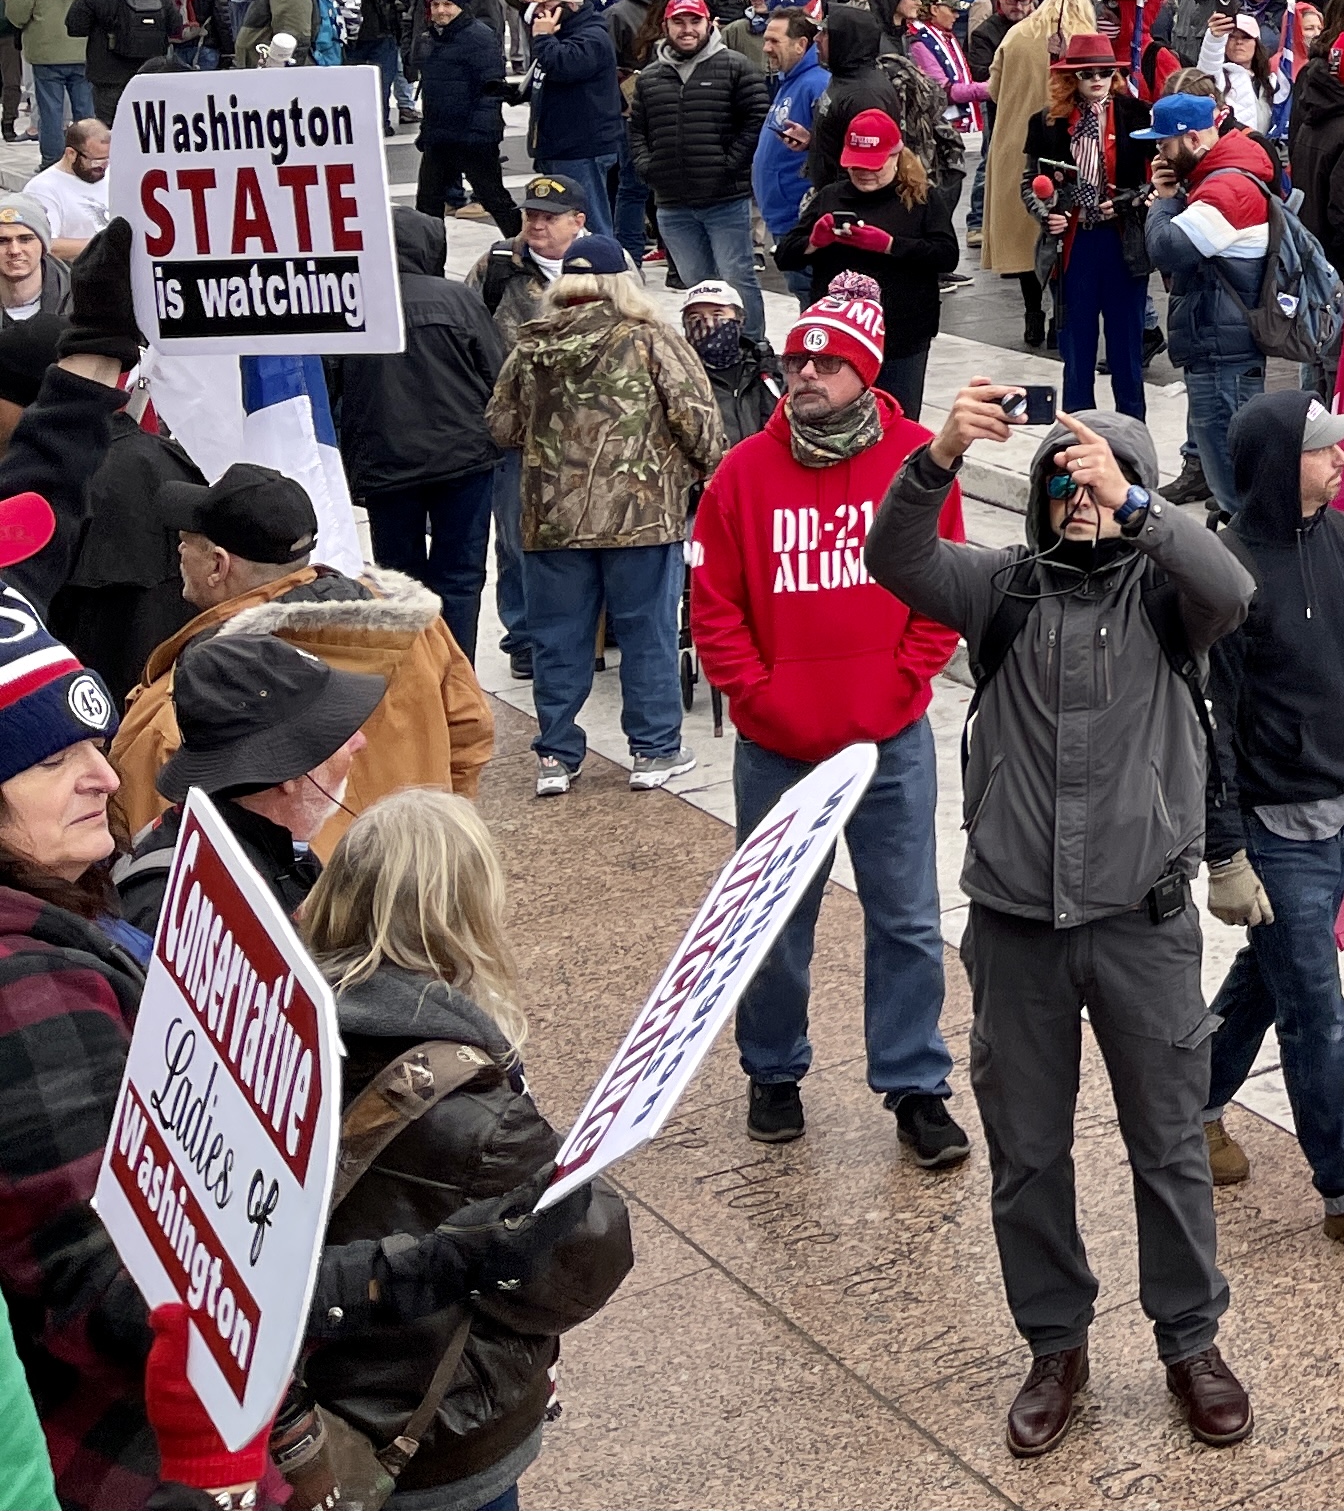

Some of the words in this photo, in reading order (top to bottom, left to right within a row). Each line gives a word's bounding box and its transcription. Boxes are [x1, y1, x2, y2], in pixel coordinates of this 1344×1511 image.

[132, 94, 354, 166] Washington
[850, 133, 880, 145] Trump
[140, 165, 364, 256] STATE
[154, 267, 184, 321] is
[197, 262, 361, 328] watching
[808, 333, 822, 346] 45
[773, 501, 875, 553] DD-21
[80, 688, 103, 717] 45
[631, 773, 857, 1129] Washington
[690, 844, 795, 1001] State
[167, 830, 313, 1157] Conservative
[562, 813, 794, 1168] WATCHING
[643, 1026, 687, 1083] is
[151, 1017, 234, 1210] Ladies
[248, 1168, 279, 1266] of
[118, 1099, 253, 1371] Washington
